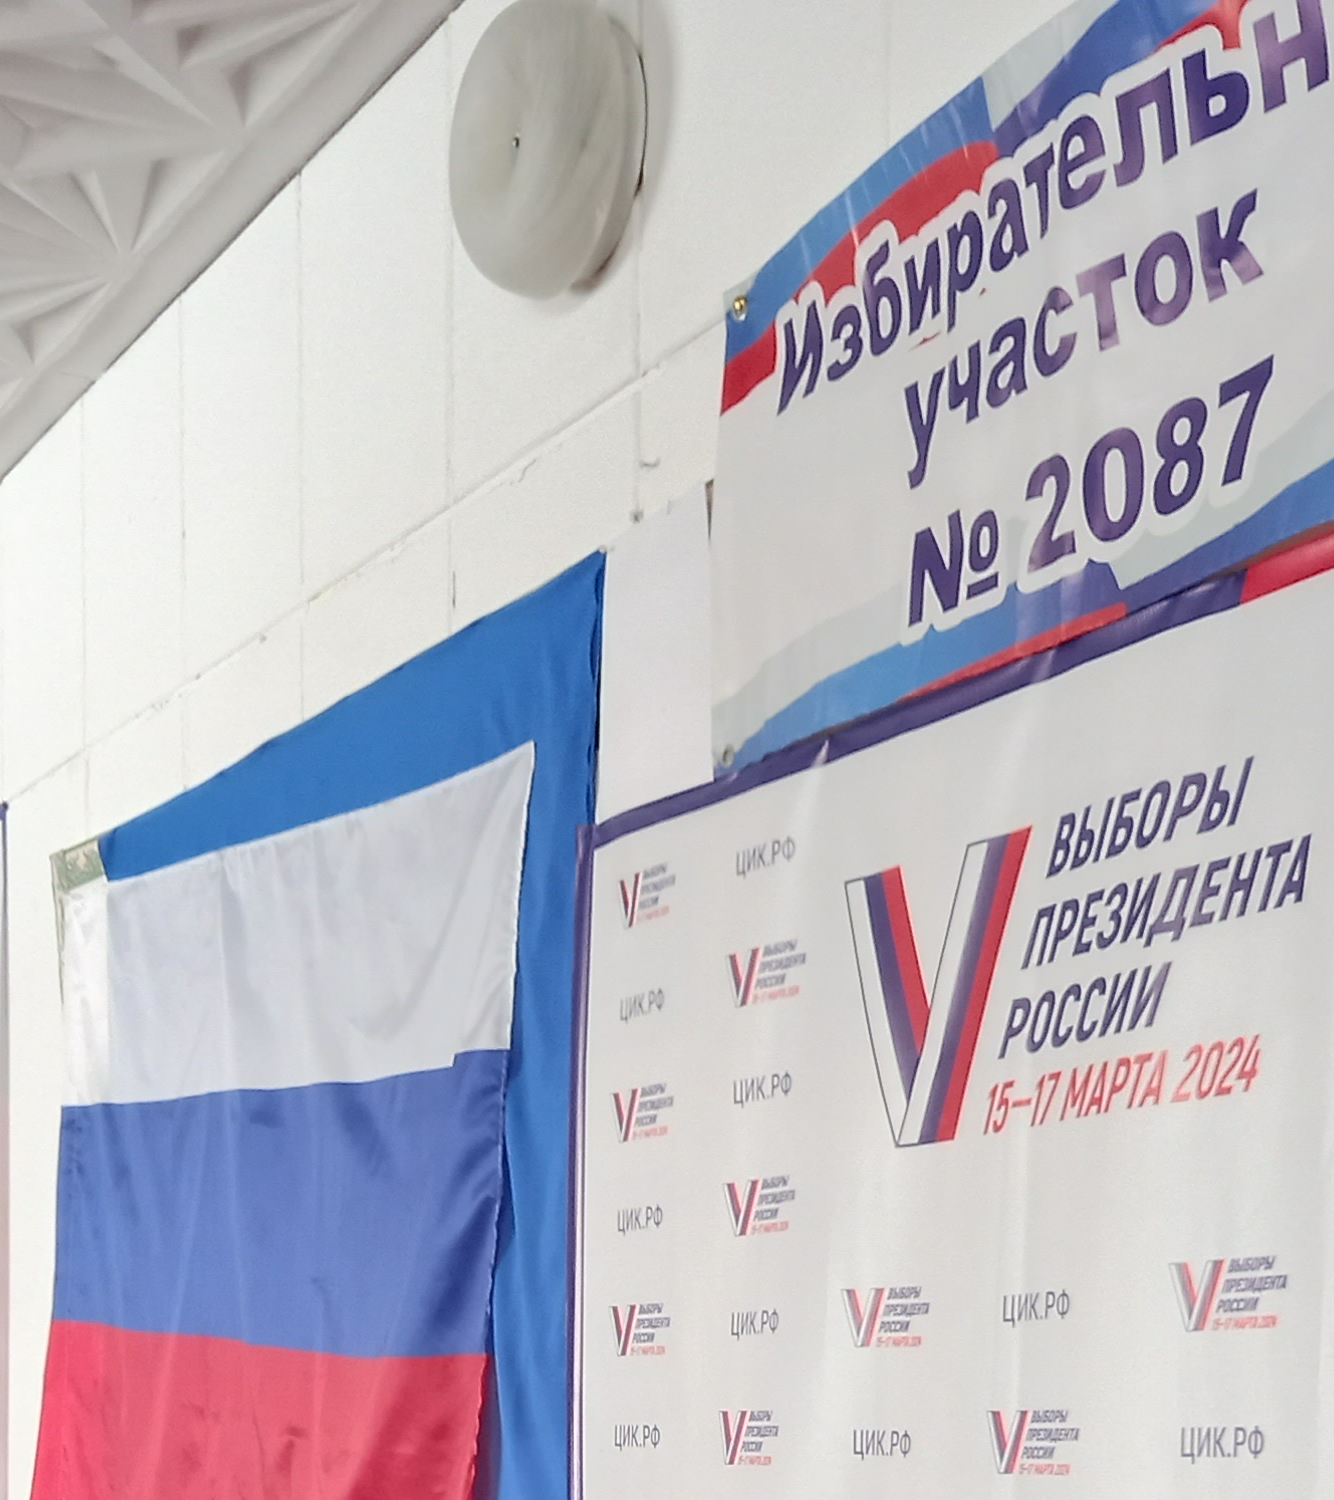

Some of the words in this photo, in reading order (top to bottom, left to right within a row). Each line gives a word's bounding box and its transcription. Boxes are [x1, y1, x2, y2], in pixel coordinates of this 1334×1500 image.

[904, 189, 1265, 488] участок
[907, 508, 1000, 627] №
[1026, 355, 1275, 573] 2087
[1045, 756, 1254, 878] ВЫБОРЫ
[736, 836, 795, 879] ЦИК.РФ
[1020, 834, 1312, 970] ПРЕЗИДЕНТА
[620, 988, 665, 1024] ЦИК.РФ
[998, 961, 1172, 1059] РОССИИ
[734, 1071, 792, 1108] ЦИК.РФ
[1060, 1050, 1169, 1121] МАРТА
[1170, 1034, 1260, 1103] 2024
[618, 1204, 663, 1236] ЦИК.РФ
[1227, 1255, 1277, 1273] ВЫБОРЫ
[731, 1308, 779, 1341] ЦИК.РФ
[1003, 1289, 1070, 1328] ЦИК.РФ
[615, 1424, 660, 1451] ЦИК.РФ
[853, 1430, 911, 1461] ЦИК.РФ
[1181, 1426, 1265, 1464] ЦИК.РФ
